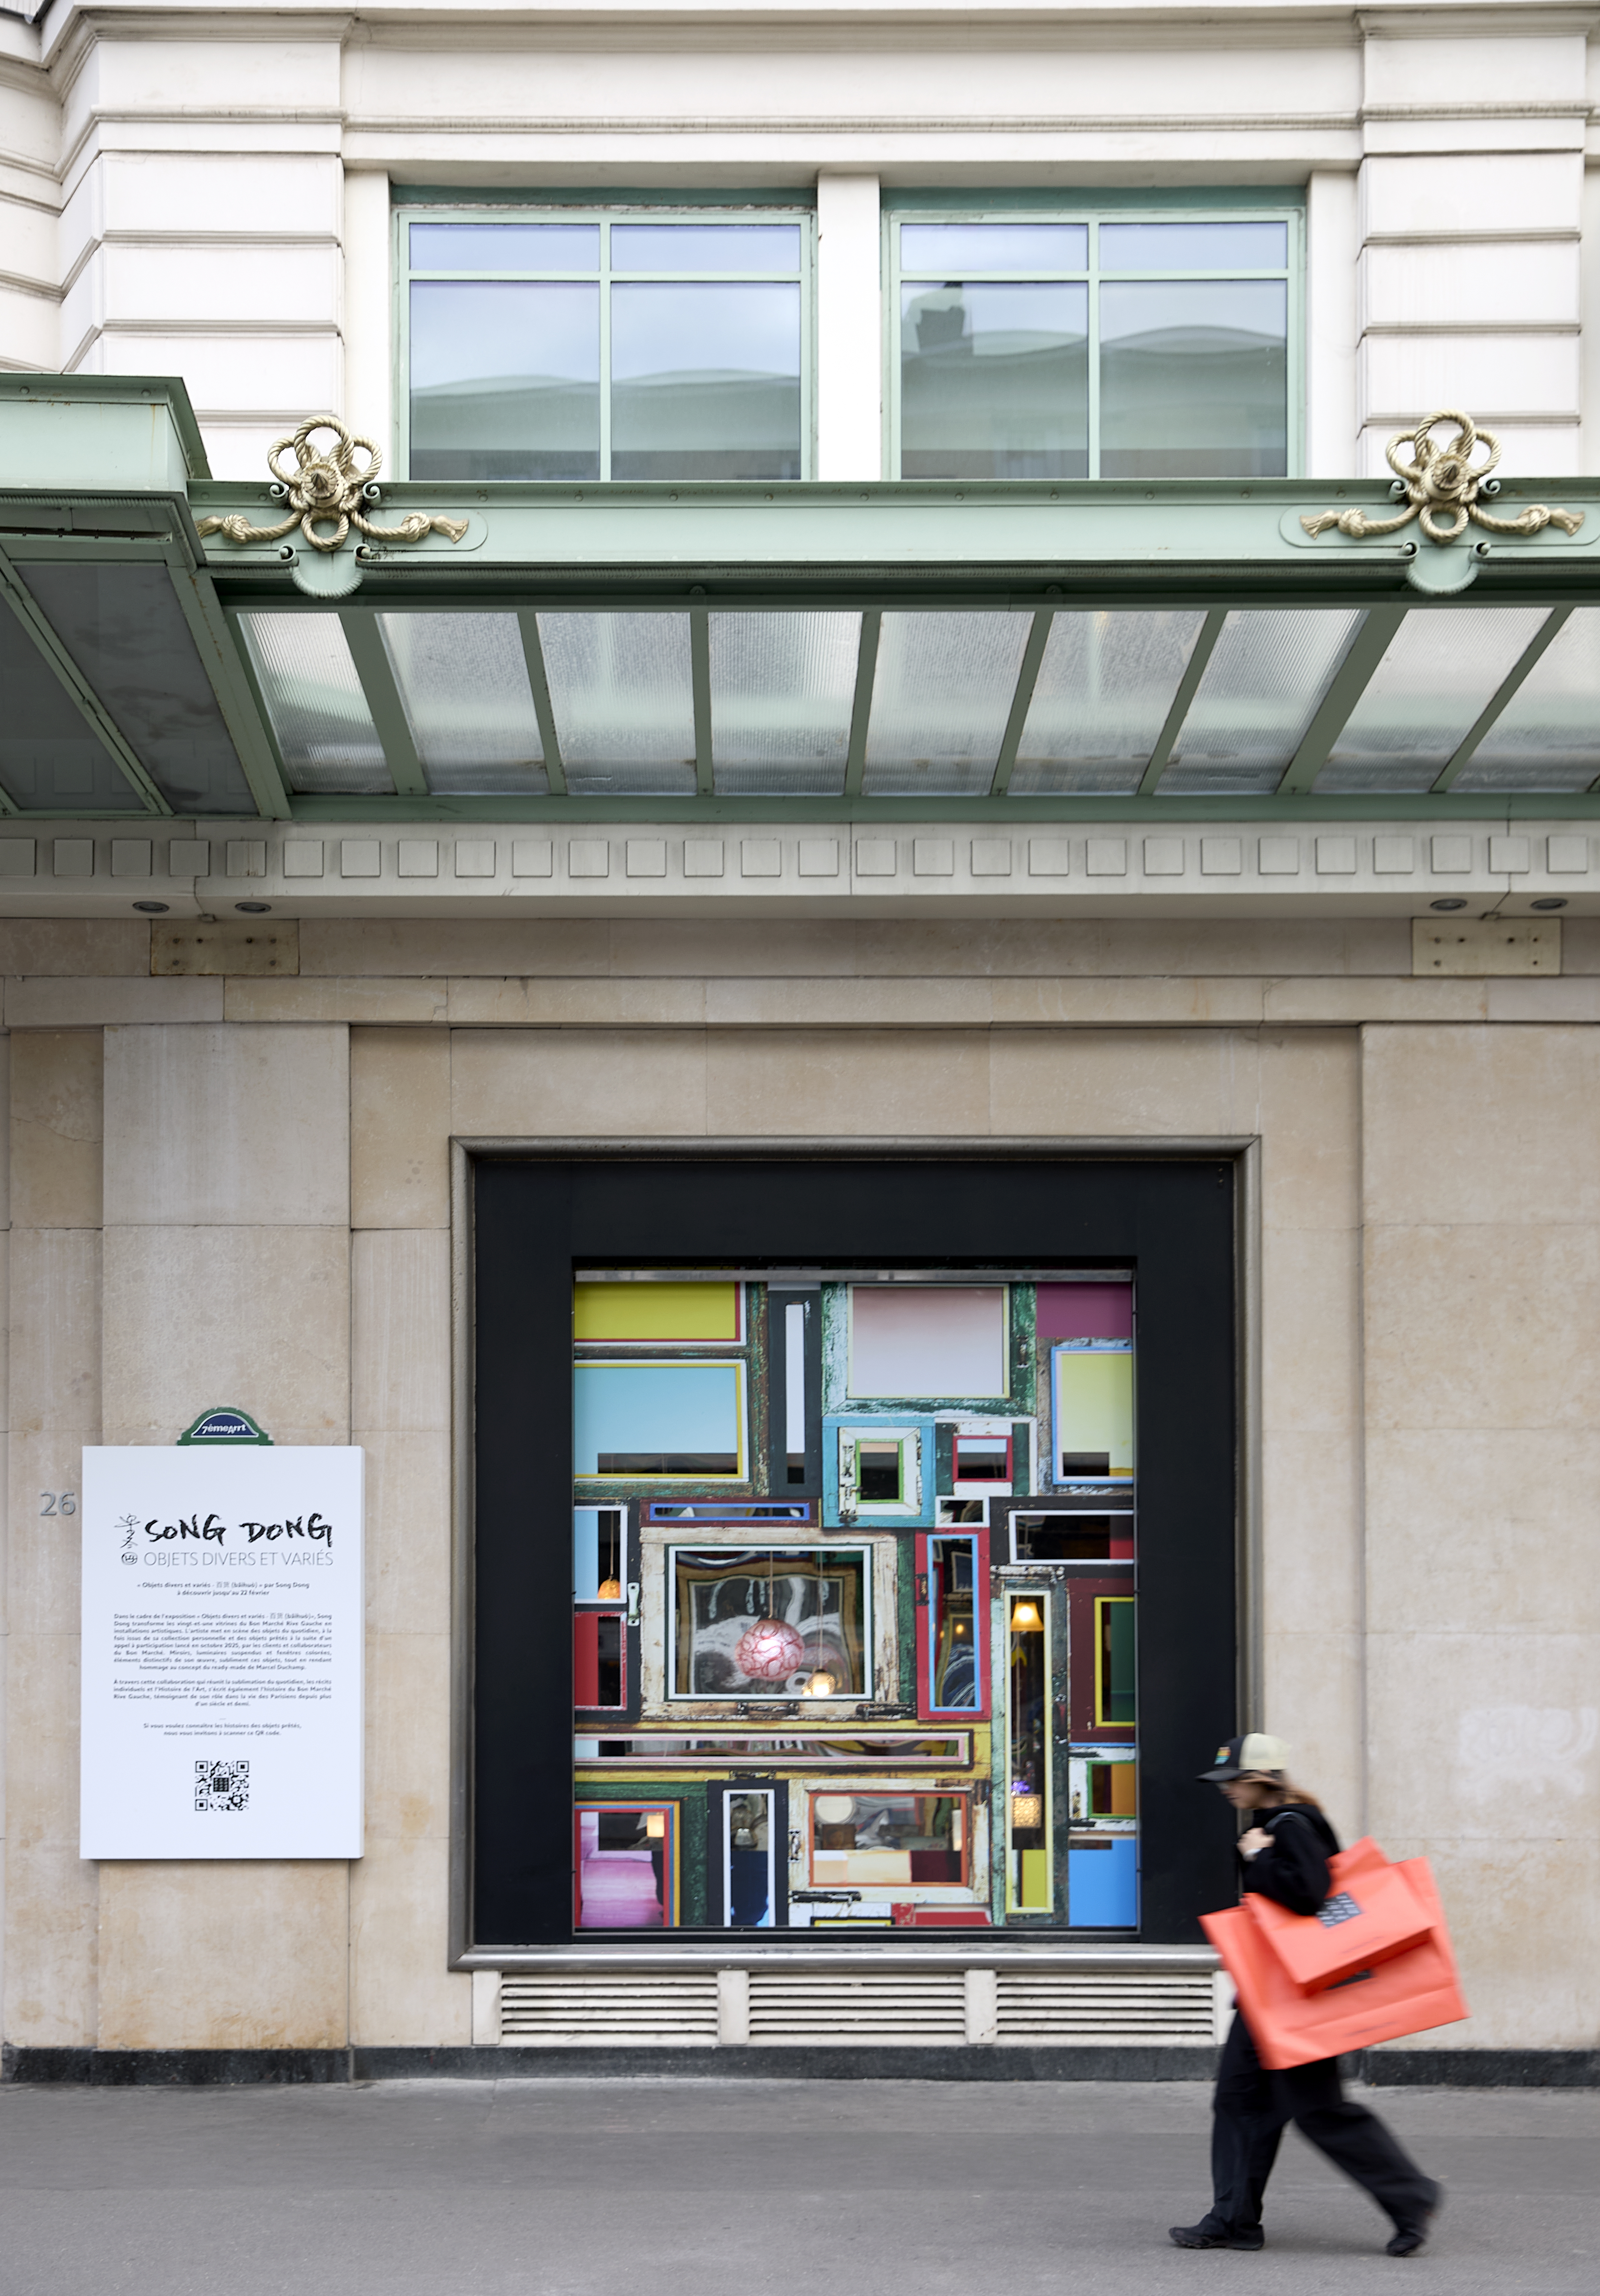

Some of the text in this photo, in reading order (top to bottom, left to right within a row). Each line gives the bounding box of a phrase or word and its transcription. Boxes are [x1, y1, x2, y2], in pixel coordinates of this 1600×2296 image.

[41, 1492, 76, 1515] 26
[145, 1514, 226, 1546] SONG
[239, 1513, 332, 1548] DONG
[144, 1552, 198, 1567] OBJETS
[203, 1552, 255, 1565] DIVERS
[261, 1553, 278, 1565] ET
[281, 1549, 333, 1565] VARIÉS
